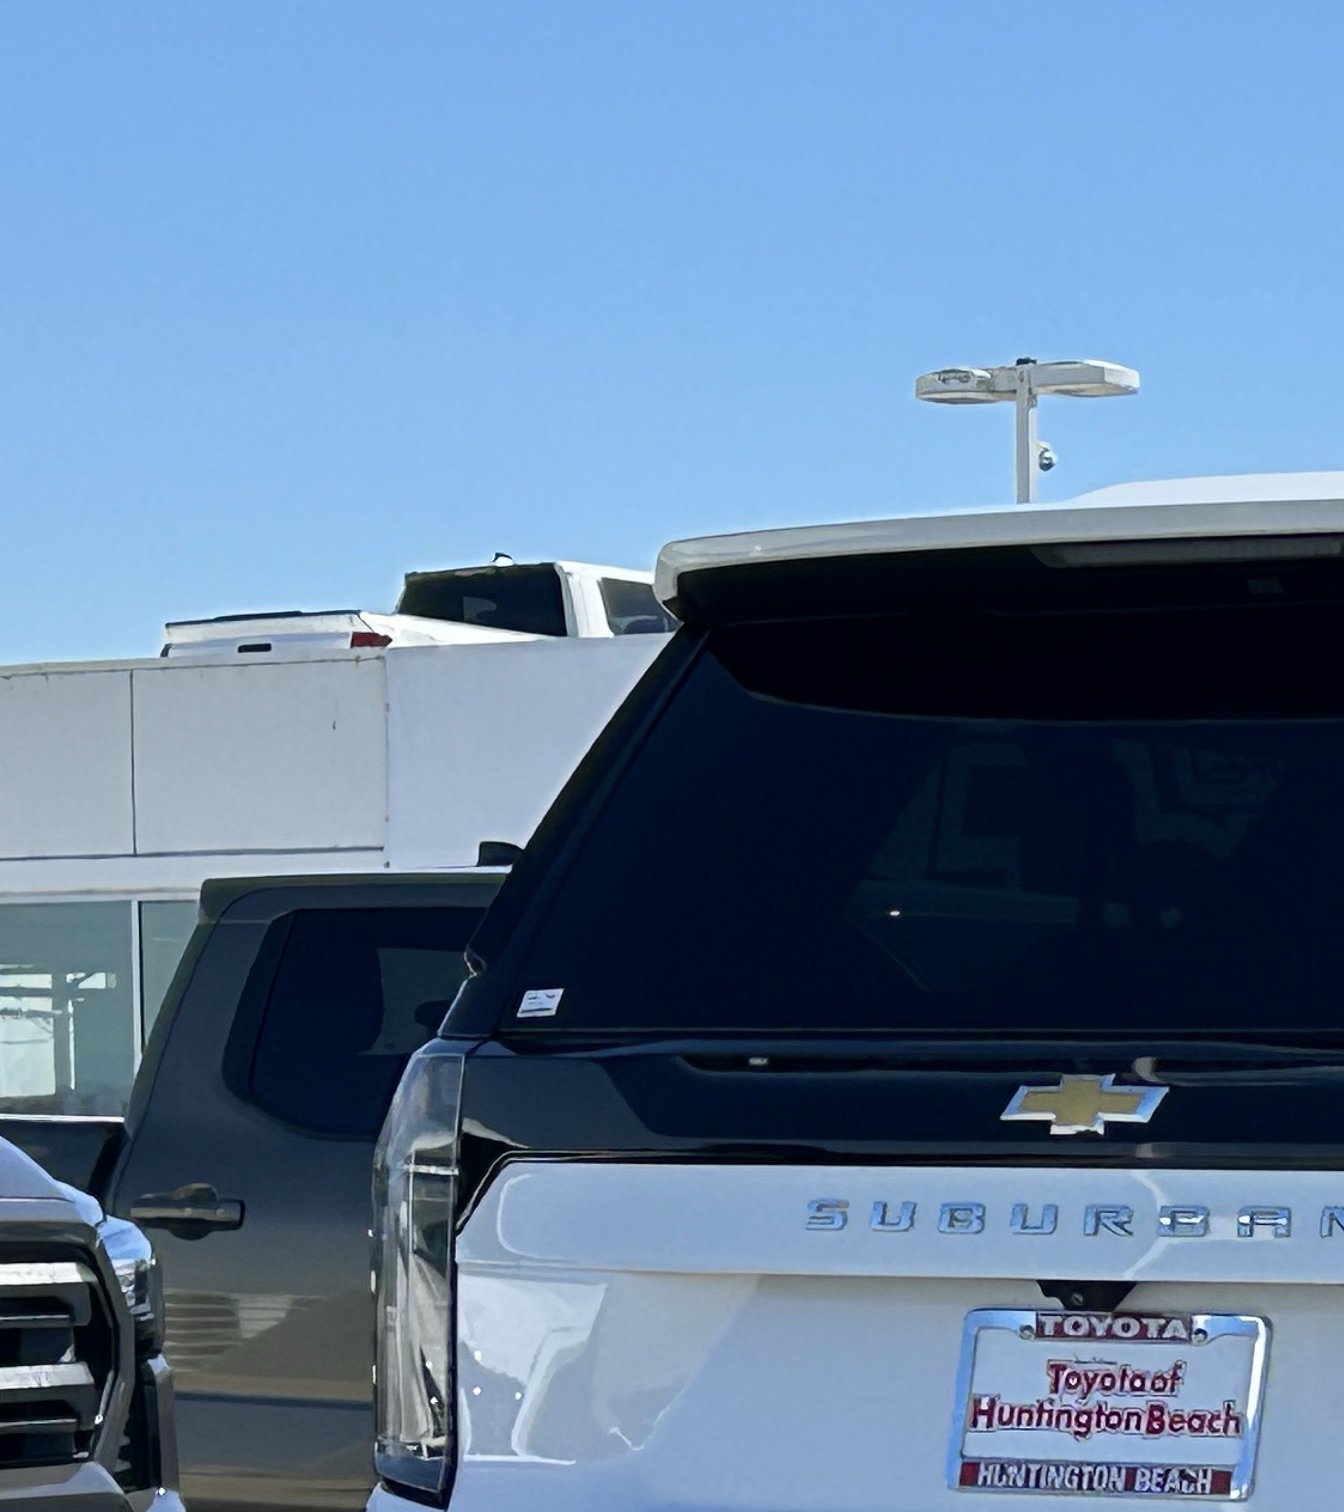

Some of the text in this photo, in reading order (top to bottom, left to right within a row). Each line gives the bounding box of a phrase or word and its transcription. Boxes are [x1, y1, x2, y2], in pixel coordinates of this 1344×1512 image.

[1038, 1314, 1190, 1340] TOYOTA
[1048, 1361, 1184, 1400] Toyota of
[970, 1397, 1241, 1438] Huntington Beach
[976, 1461, 1213, 1495] HUNTINGTON BEACH
